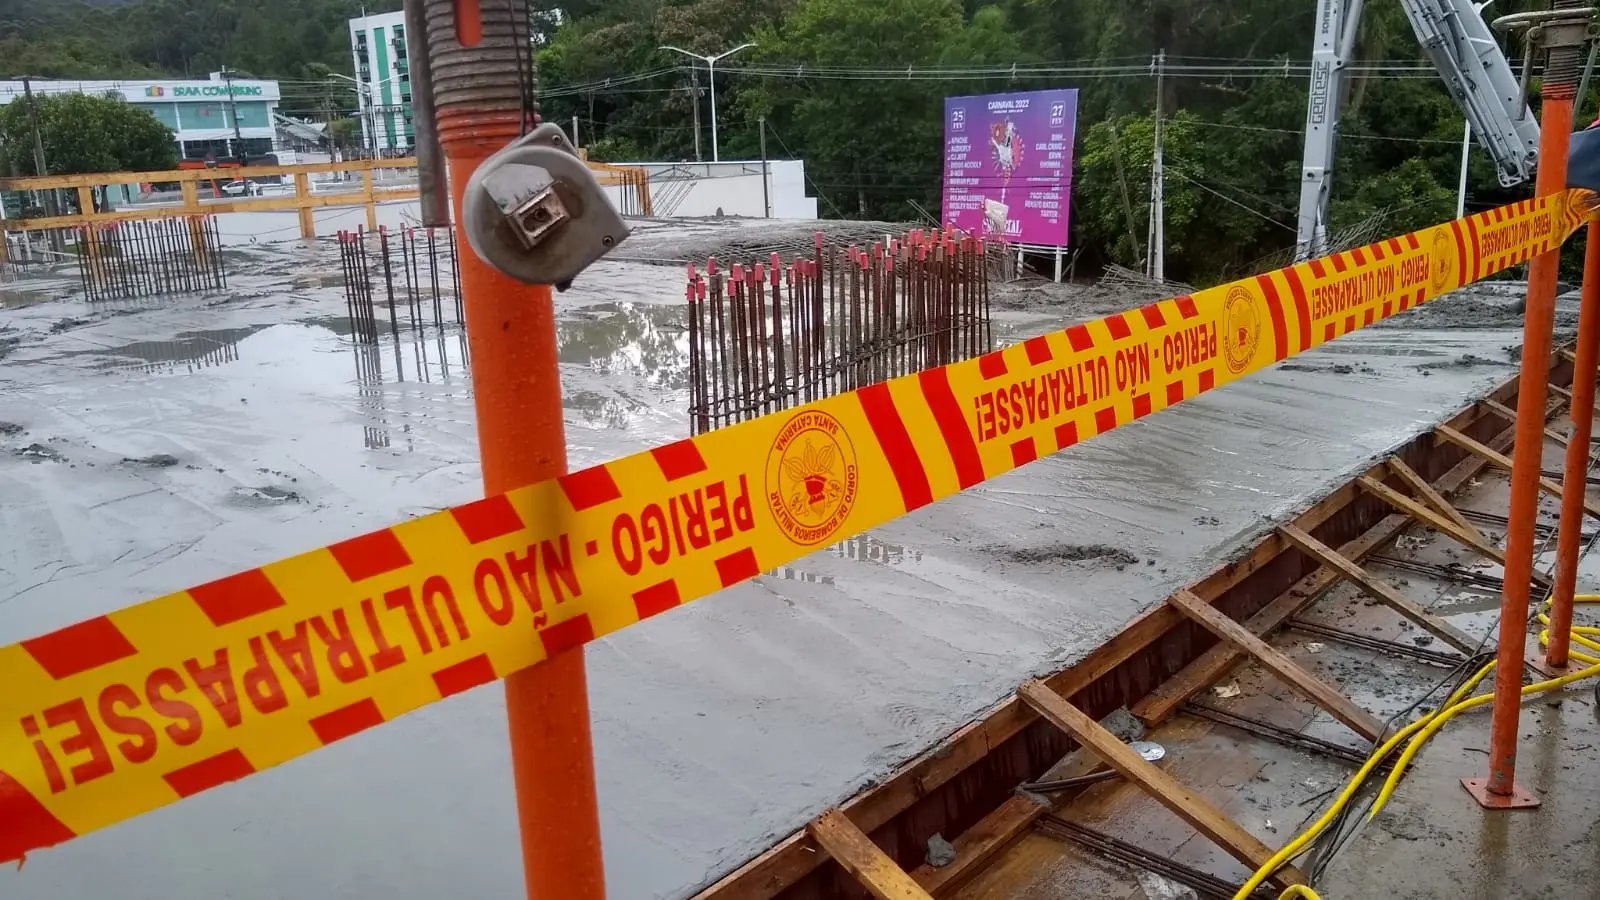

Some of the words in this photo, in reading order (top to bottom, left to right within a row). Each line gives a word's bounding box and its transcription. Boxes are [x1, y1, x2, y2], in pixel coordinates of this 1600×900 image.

[952, 111, 964, 122] 25
[987, 100, 1014, 110] CARNAVAL
[1015, 99, 1030, 108] 2022
[1051, 105, 1063, 116] 27
[1377, 263, 1394, 302] NÃO
[1402, 252, 1430, 289] PERIGO
[1312, 270, 1374, 321] ULTRAPASSE!
[1163, 320, 1218, 374] PERIGO
[1115, 342, 1150, 397] NÃO
[974, 355, 1111, 443] ULTRAPASSE!
[775, 415, 812, 451] CATARINA
[814, 415, 838, 435] SANTA
[846, 464, 855, 503] CORPO
[612, 473, 755, 576] PERIGO
[770, 491, 794, 533] MILITAR
[794, 518, 838, 541] BOMBEIROS
[837, 507, 848, 519] DE
[474, 534, 581, 630] NÃO
[19, 575, 470, 794] ULTRAPASSE!
